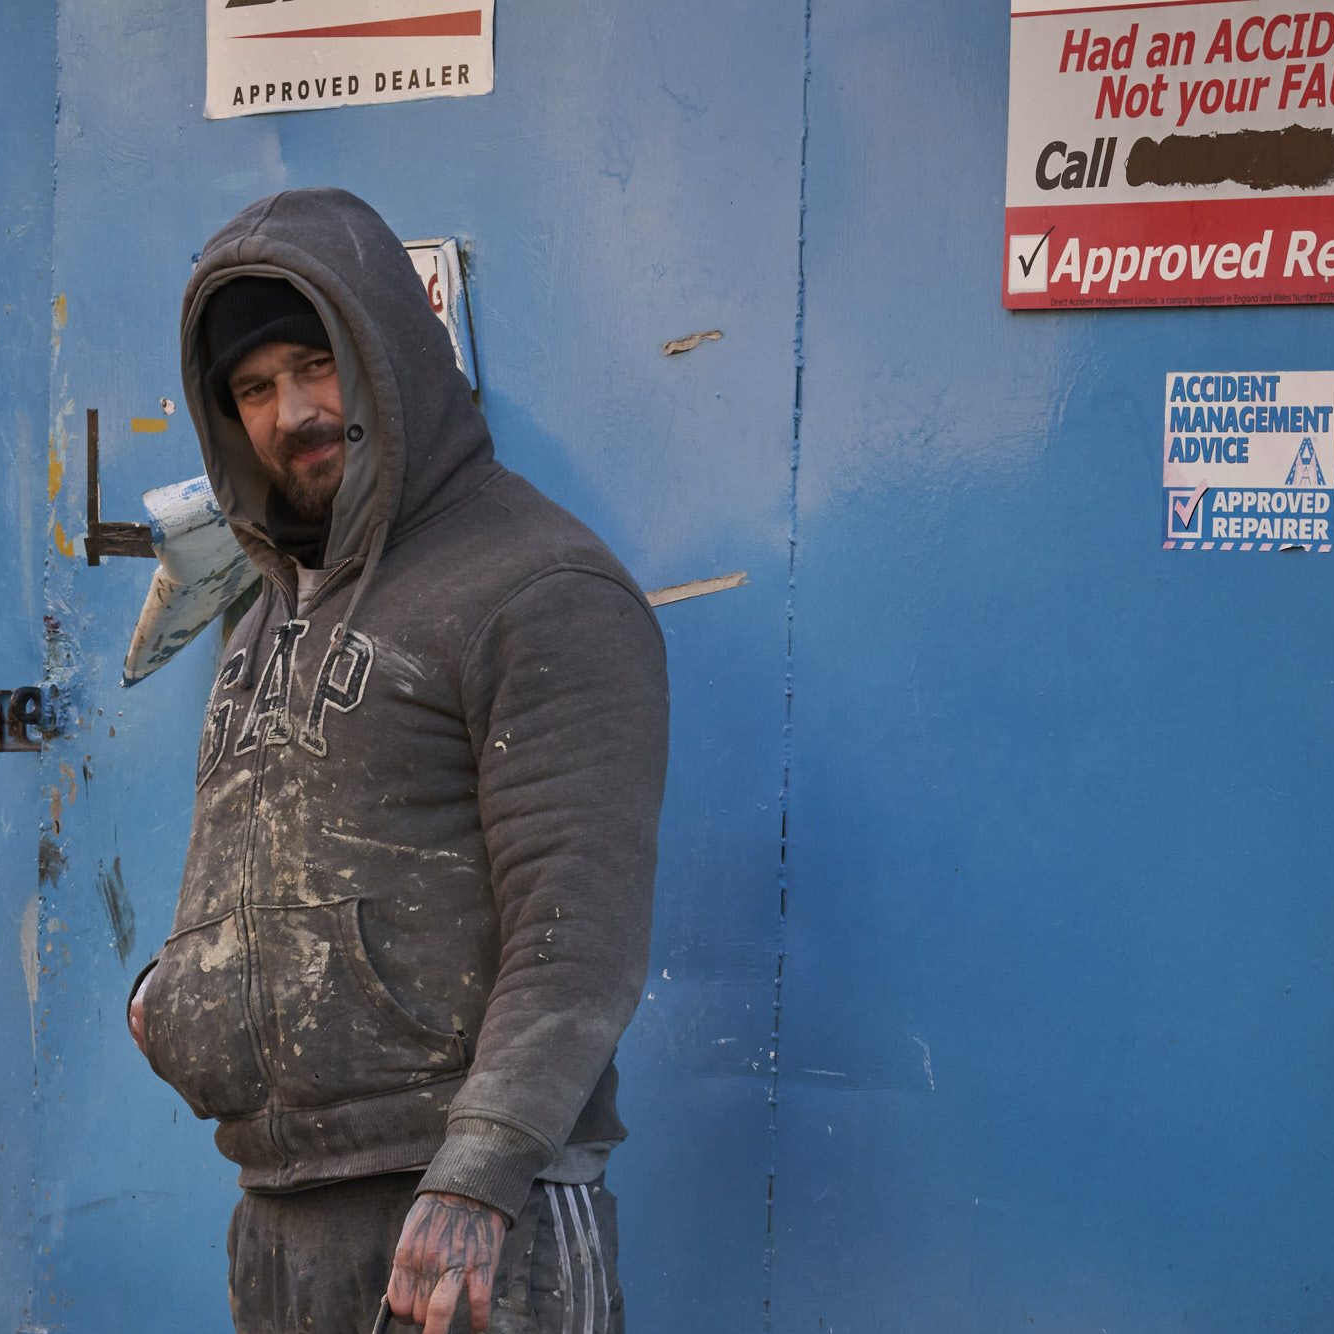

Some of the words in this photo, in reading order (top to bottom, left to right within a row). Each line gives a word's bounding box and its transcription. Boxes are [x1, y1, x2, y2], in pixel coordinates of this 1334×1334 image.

[1059, 23, 1139, 73] Had
[1146, 29, 1195, 68] an
[232, 75, 359, 106] APPROVED
[375, 64, 470, 92] DEALER
[1095, 74, 1167, 119] Not
[1176, 76, 1270, 127] your
[1035, 137, 1117, 190] Call
[1050, 229, 1273, 294] Approved
[1069, 297, 1094, 306] Accident
[1096, 297, 1133, 306] Management
[1166, 297, 1192, 306] company
[1195, 296, 1225, 305] registered
[1234, 294, 1258, 304] England
[1260, 294, 1272, 302] and
[1273, 293, 1291, 302] Wales
[1292, 293, 1317, 302] Number
[1170, 375, 1280, 402] ACCIDENT
[1170, 406, 1333, 433] MANAGEMENT
[1168, 437, 1249, 464] ADVICE
[1212, 491, 1330, 514] APPROVED
[1212, 517, 1329, 540] REPAIRER
[196, 619, 375, 792] GAP
